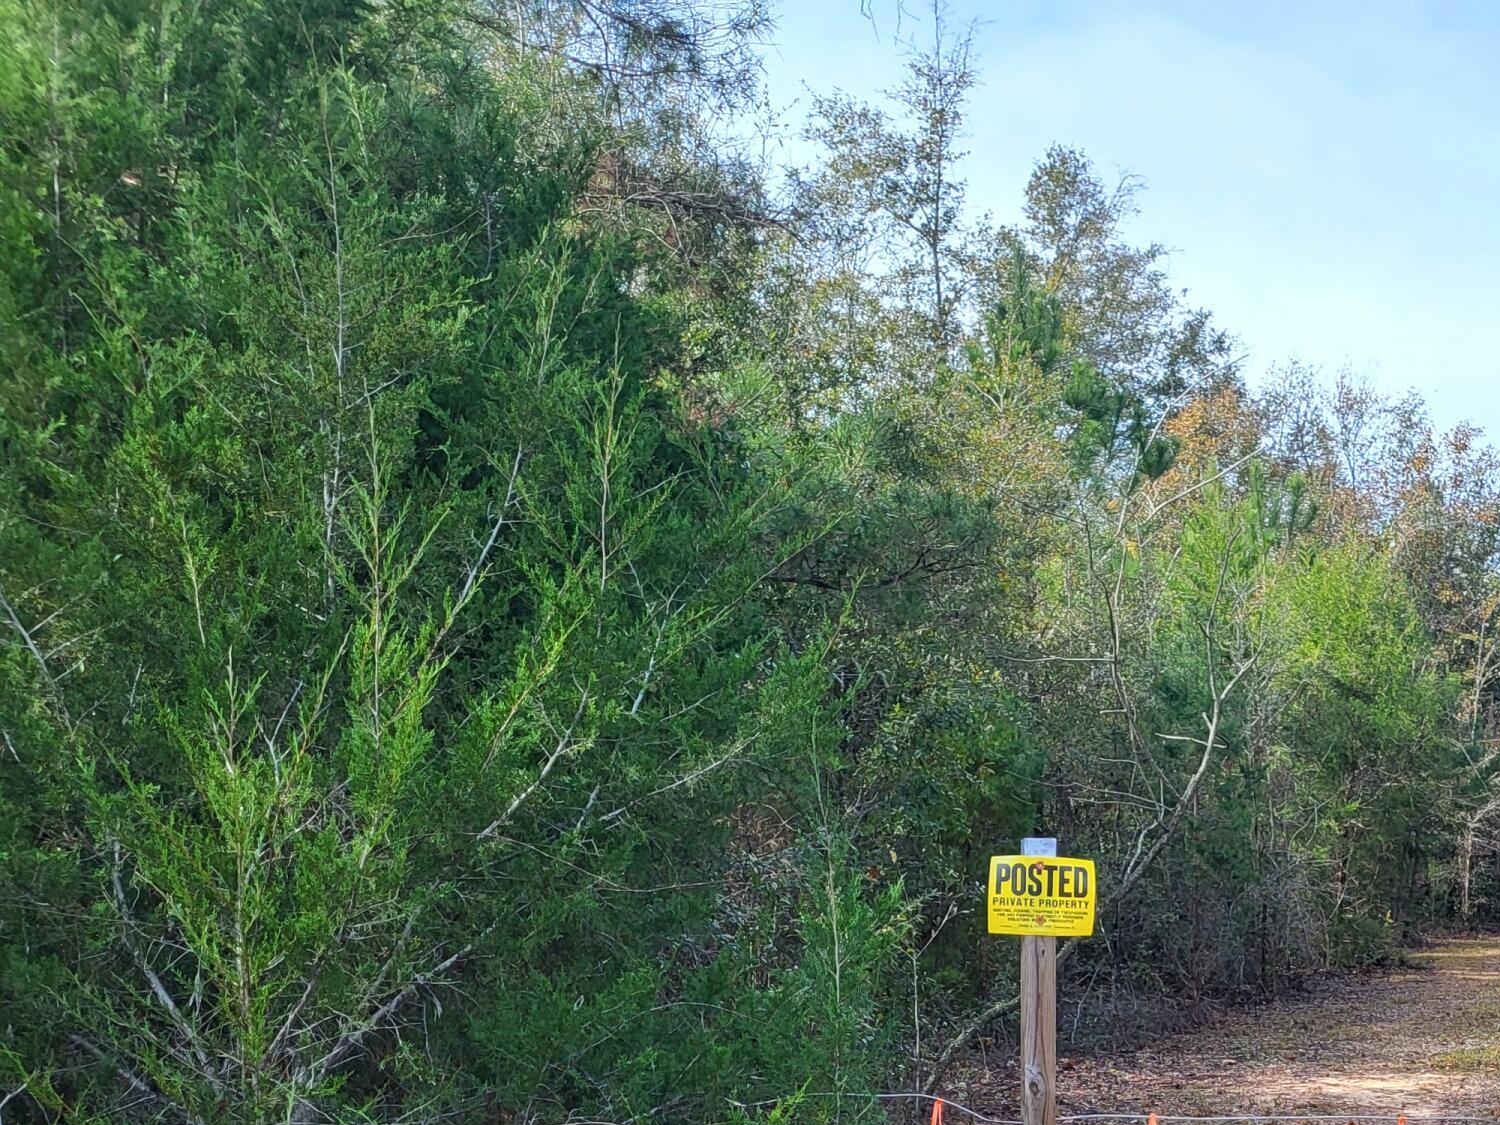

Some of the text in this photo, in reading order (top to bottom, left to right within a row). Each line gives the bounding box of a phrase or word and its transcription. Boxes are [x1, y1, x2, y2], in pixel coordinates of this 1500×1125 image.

[995, 863, 1088, 898] POSTED
[992, 897, 1090, 909] PRIVATE PROPERTY
